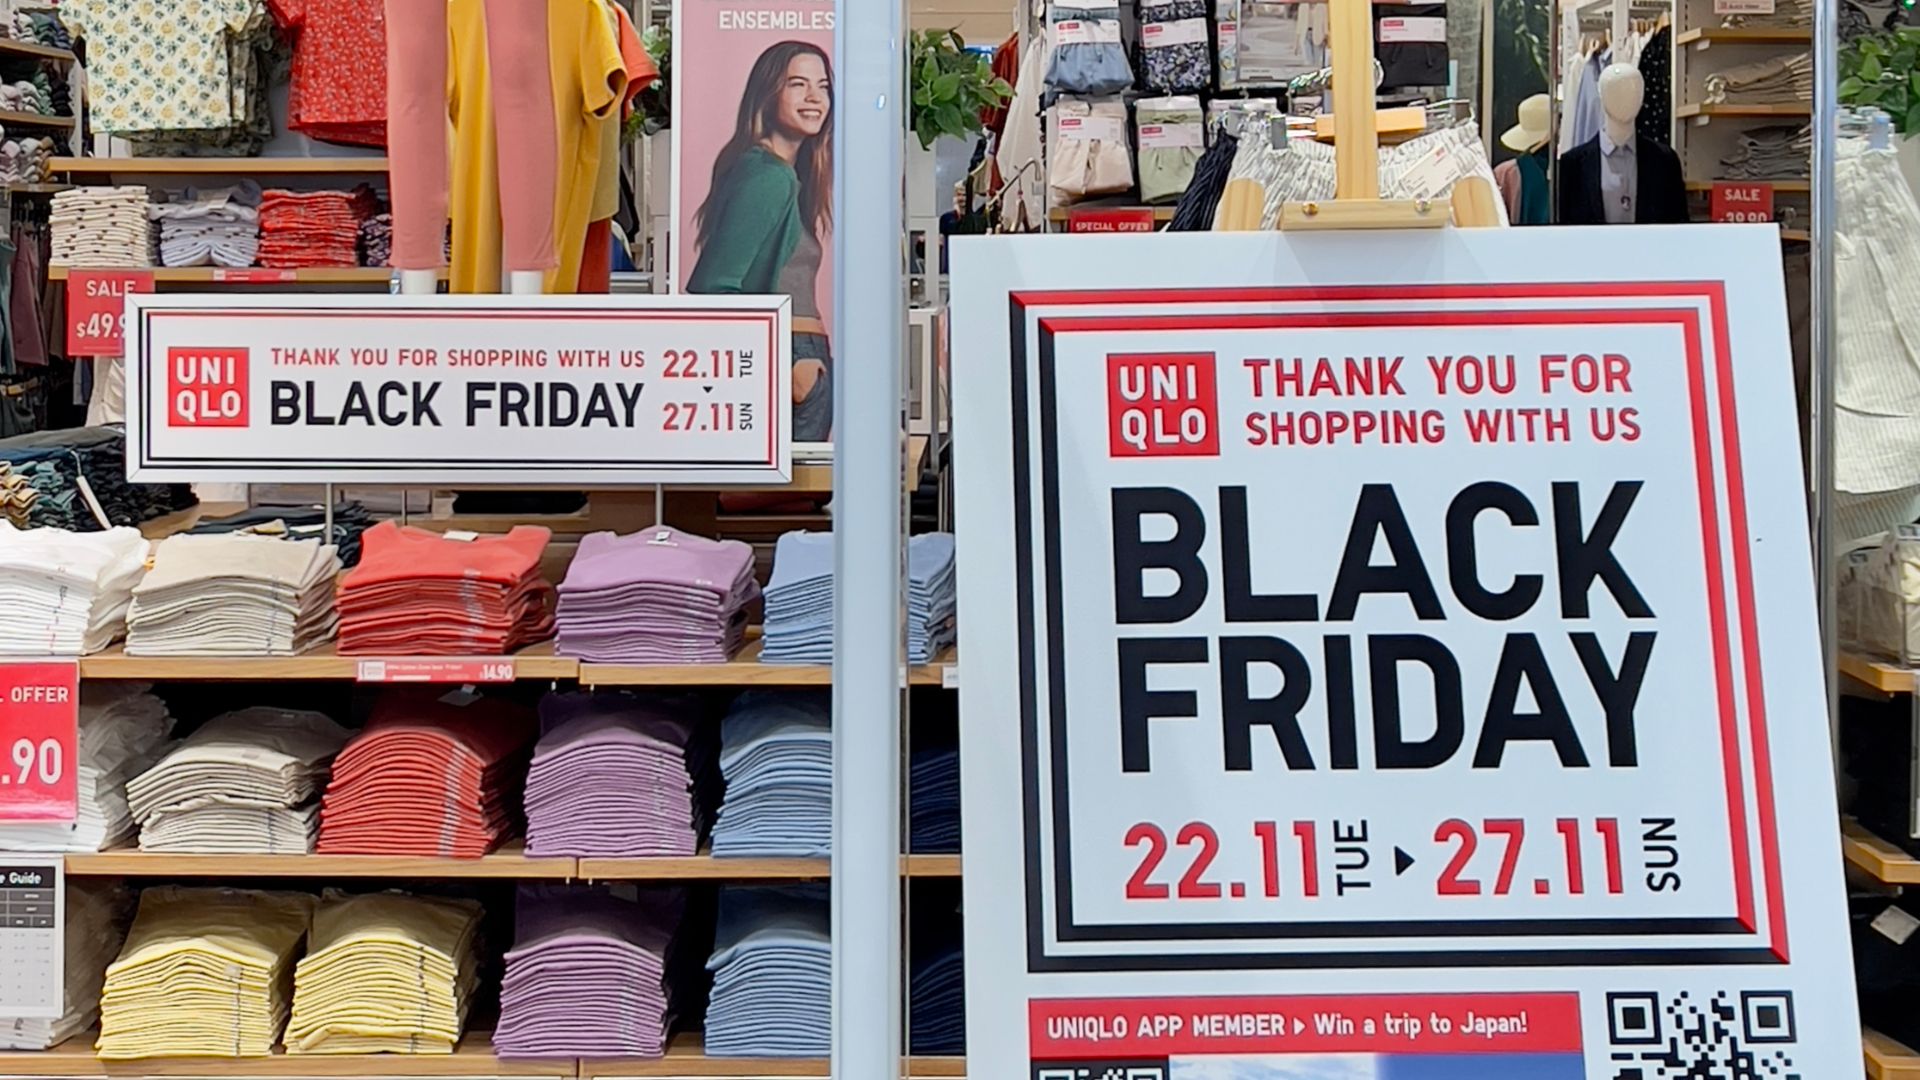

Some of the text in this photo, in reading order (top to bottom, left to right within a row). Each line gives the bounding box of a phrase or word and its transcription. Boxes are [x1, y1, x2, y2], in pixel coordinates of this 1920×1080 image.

[719, 10, 835, 29] ENSEMBLES
[1725, 189, 1761, 201] SALE
[86, 280, 136, 296] SALE
[176, 356, 234, 385] UNI
[271, 349, 644, 368] THANK YOU FOR SHOPPING WITH US
[663, 350, 753, 378] 22.11 TUE
[1120, 364, 1197, 401] UNI
[1243, 354, 1633, 398] THANK YOU FOR
[176, 390, 241, 423] QLO
[271, 381, 644, 427] BLACK FRIDAY
[663, 403, 753, 431] 27.11 SUN
[1122, 408, 1207, 450] QLO
[1245, 407, 1641, 446] SHOPPING WITH US
[1111, 481, 1656, 624] BLACK
[11, 686, 69, 702] OFFER
[1117, 632, 1657, 773] FRIDAY
[1123, 817, 1682, 900] 22.11 TUE 27.11 SUN
[9, 872, 42, 884] Guide
[1047, 1011, 1528, 1041] UNIQLO APP MEMBER Win a trip to Japan!
